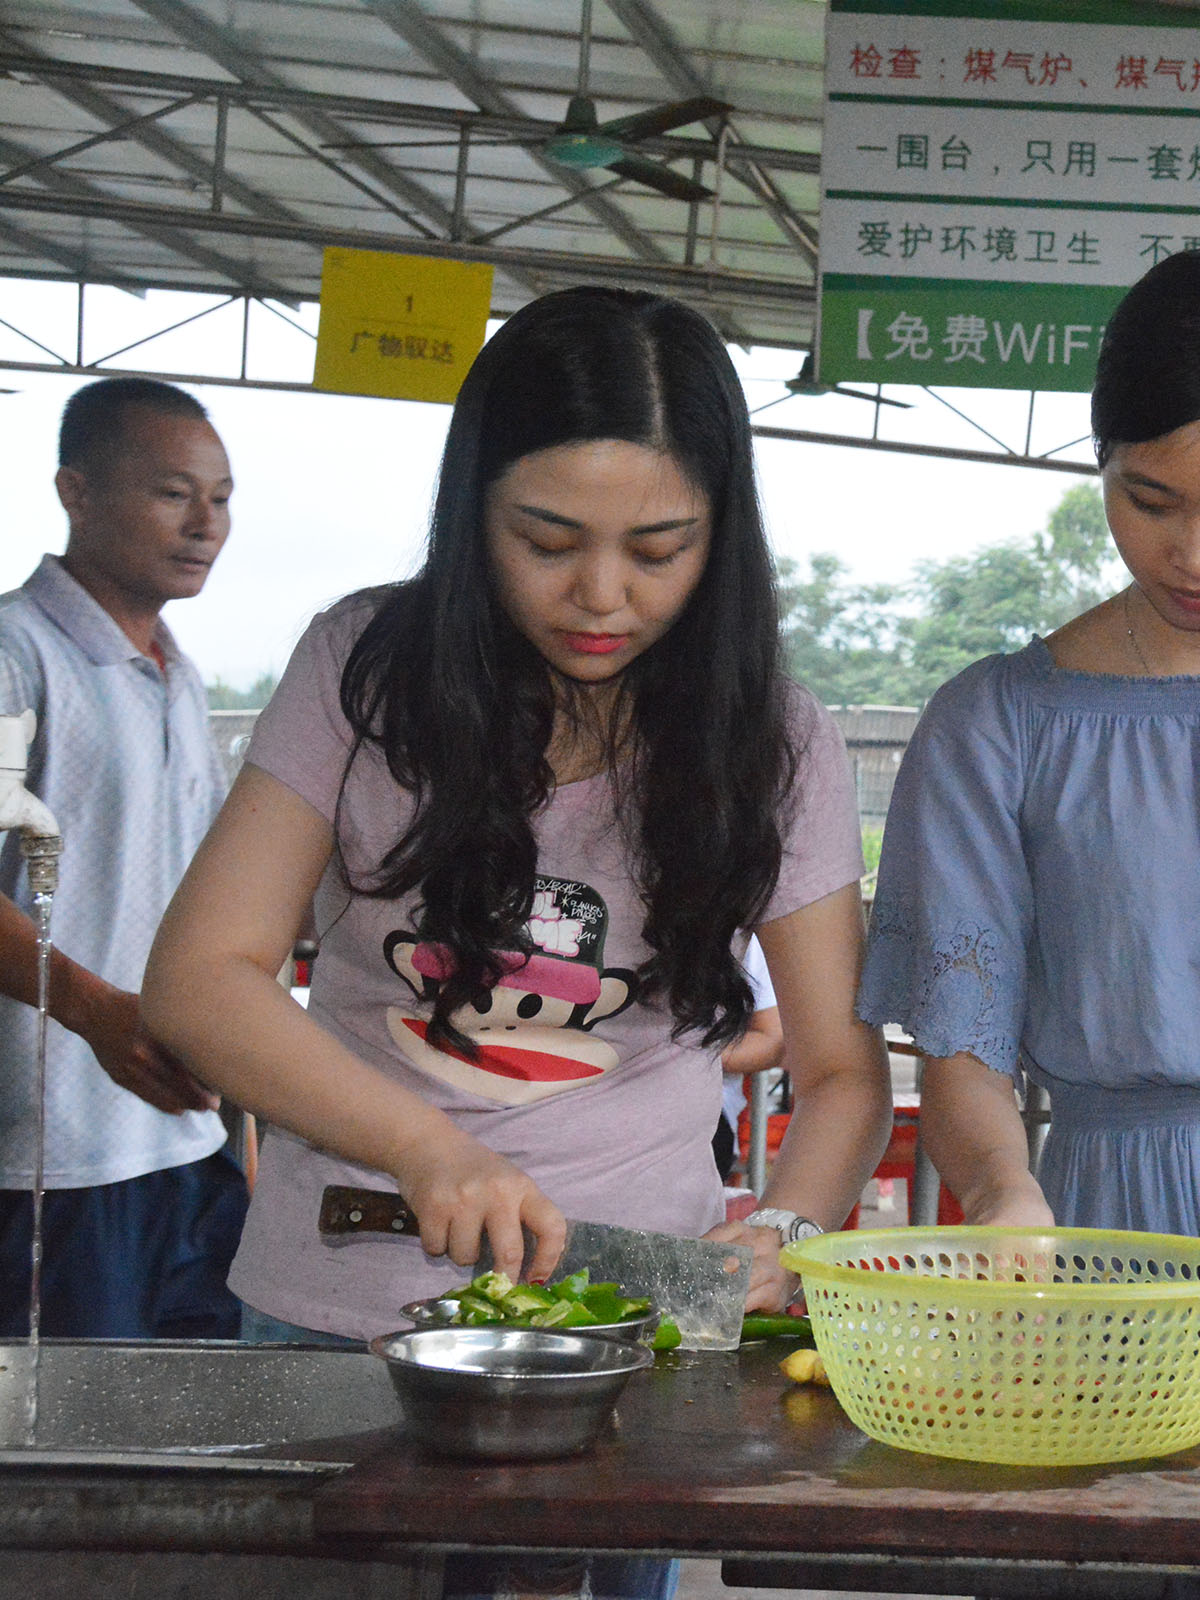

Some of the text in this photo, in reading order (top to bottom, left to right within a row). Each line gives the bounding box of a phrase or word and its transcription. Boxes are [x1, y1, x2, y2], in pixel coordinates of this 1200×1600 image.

[857, 221, 1102, 265] 爱护环境卫生
